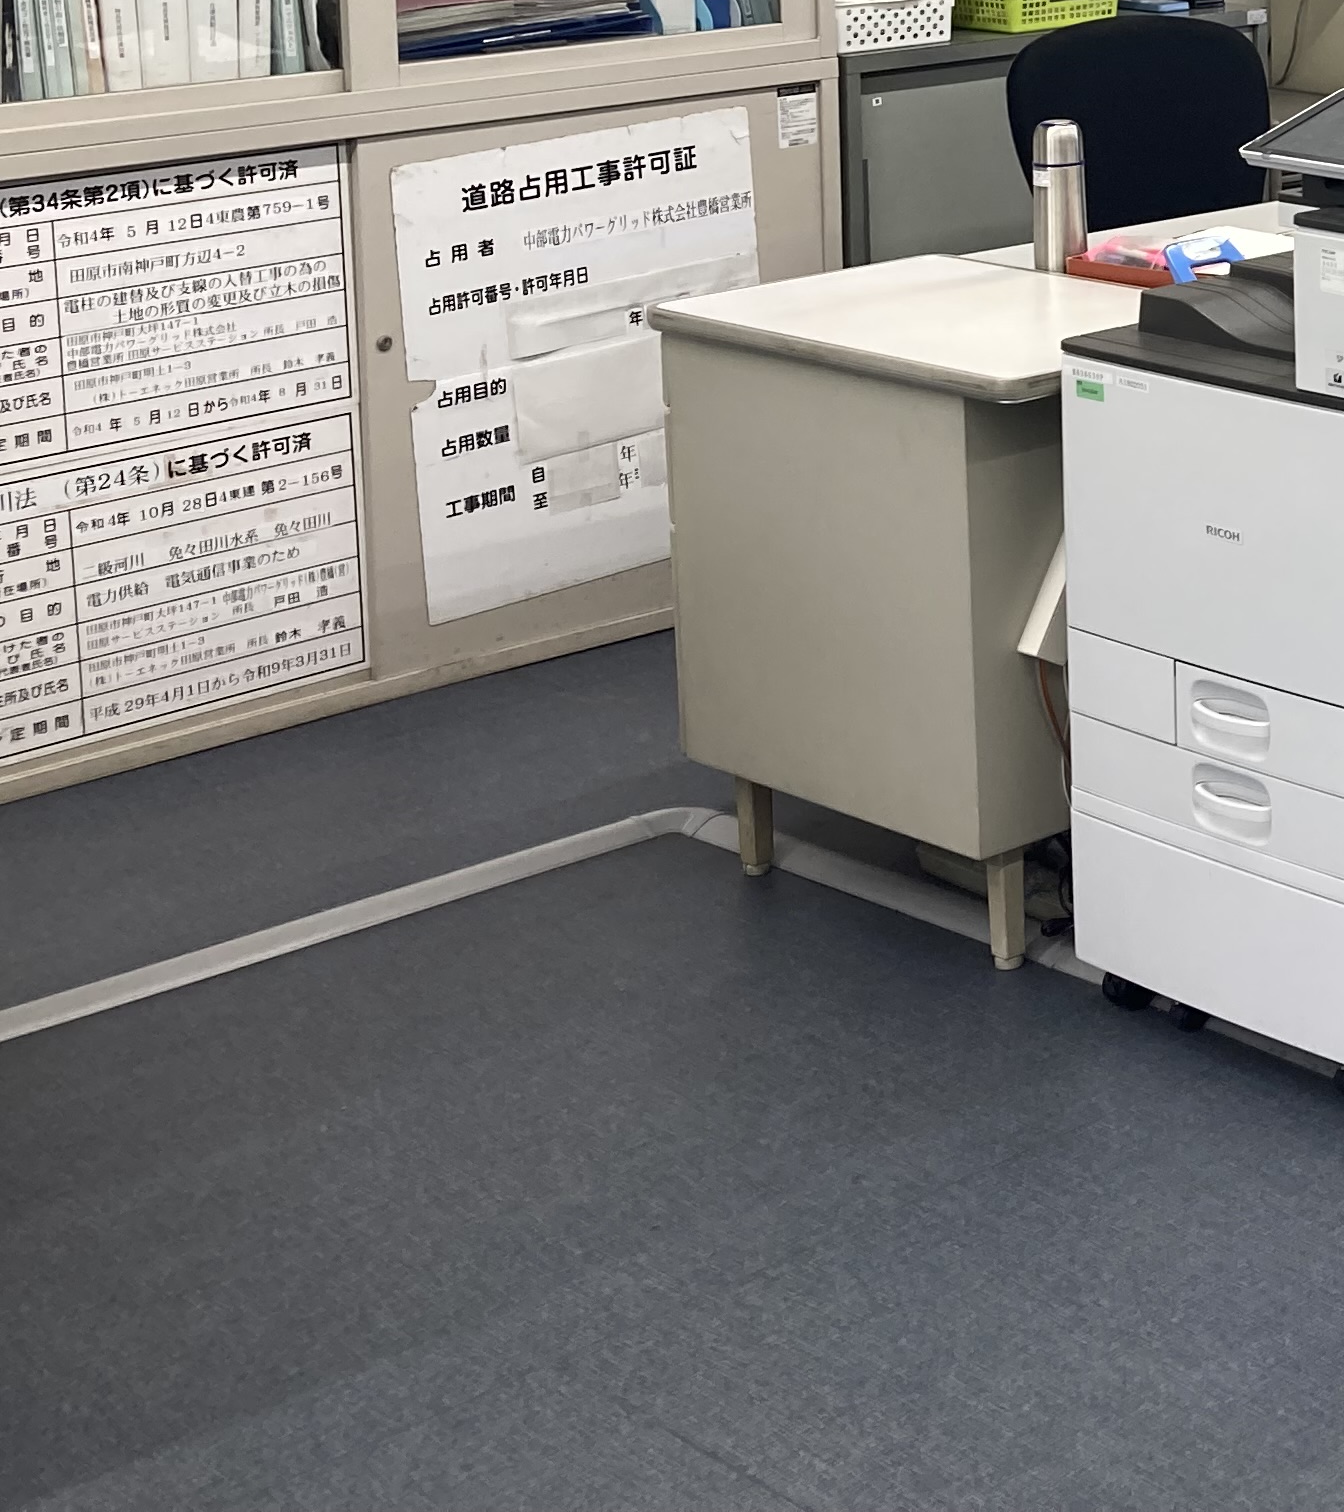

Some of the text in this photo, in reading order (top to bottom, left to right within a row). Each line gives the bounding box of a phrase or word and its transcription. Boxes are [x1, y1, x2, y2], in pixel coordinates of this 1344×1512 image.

[461, 145, 697, 213] 道路占用工事許可証
[424, 239, 496, 268] 占用者
[429, 267, 588, 316] 占用許可番号・許可年月日
[628, 310, 643, 326] 年
[437, 377, 507, 408] 占用目的
[441, 425, 511, 458] 占用数量
[532, 445, 636, 483] 自 年
[445, 486, 515, 519] 工事期間
[533, 492, 549, 511] 至
[1206, 525, 1240, 542] RICOH
